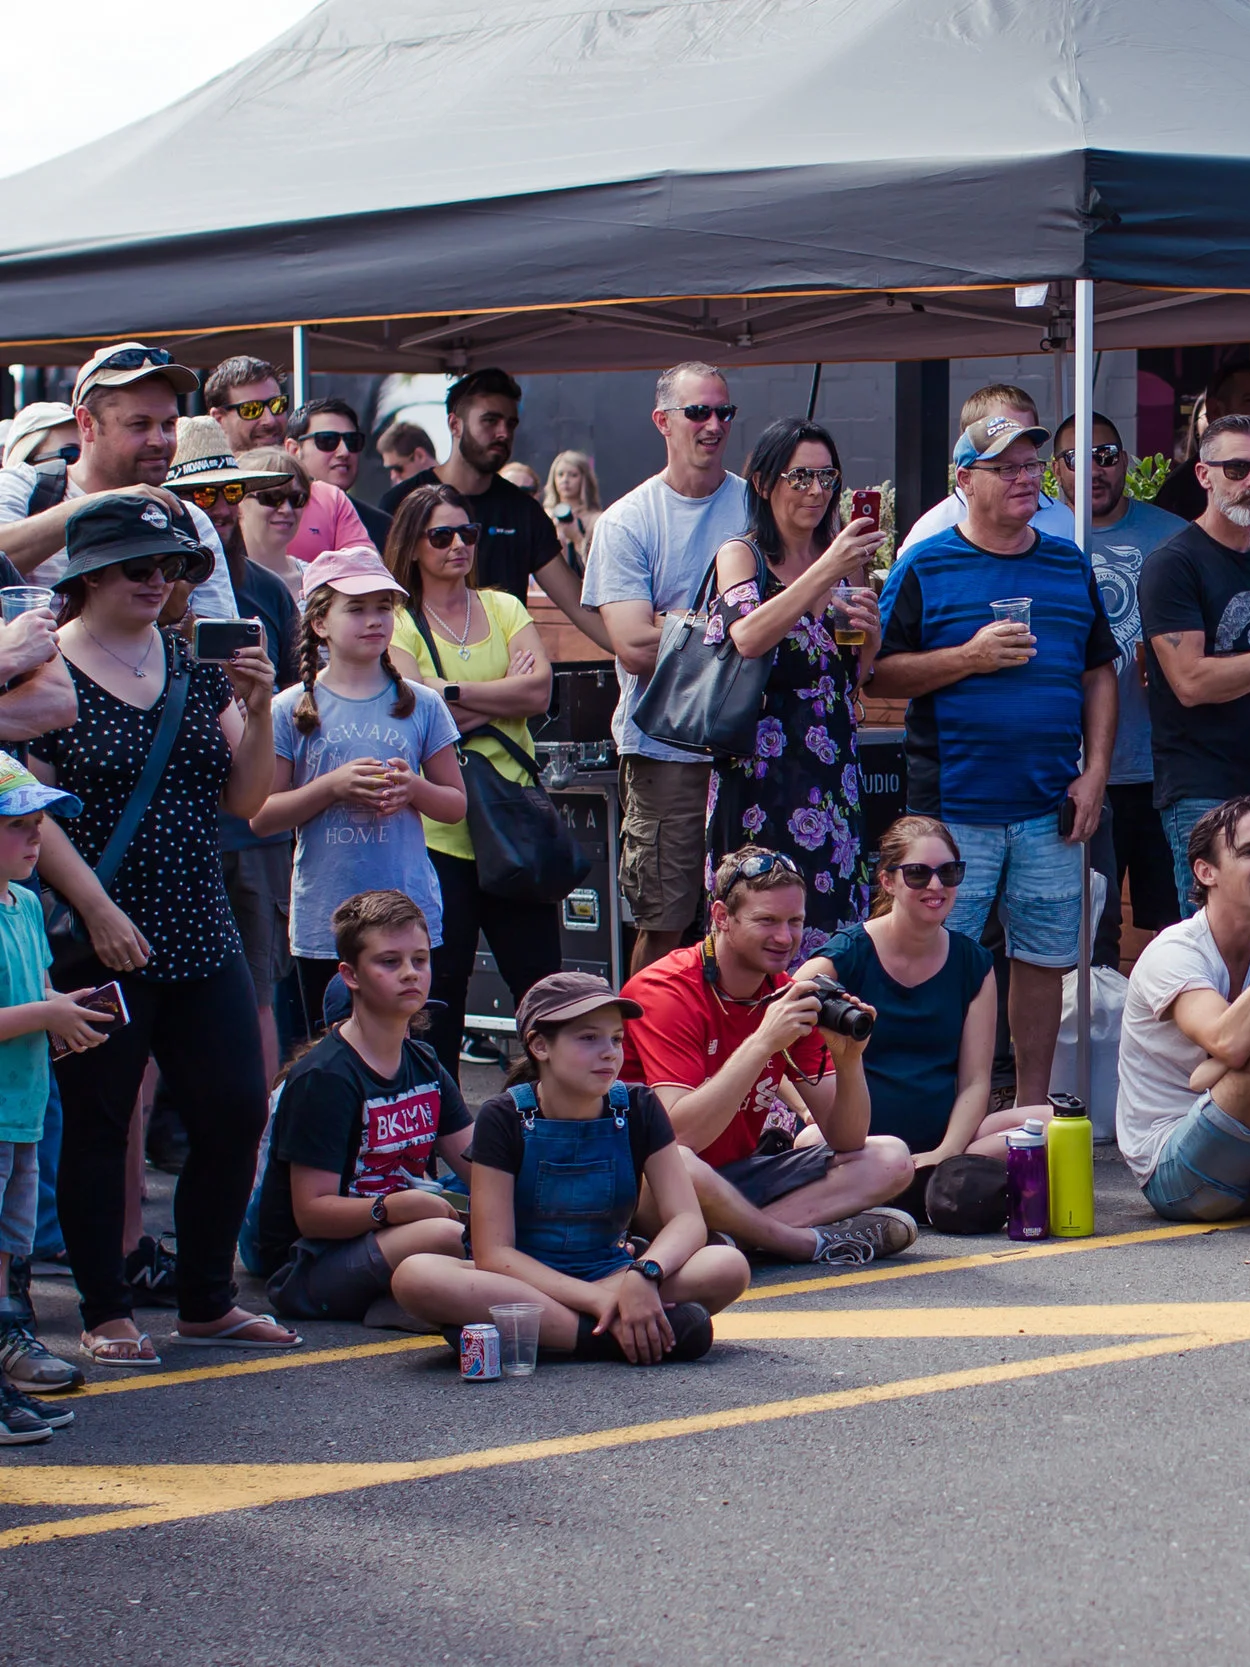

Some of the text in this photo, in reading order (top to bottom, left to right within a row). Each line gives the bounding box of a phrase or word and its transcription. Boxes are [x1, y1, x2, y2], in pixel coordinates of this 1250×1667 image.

[863, 773, 899, 793] UDIO
[325, 825, 390, 844] HOME
[377, 1102, 434, 1140] BKLYN
